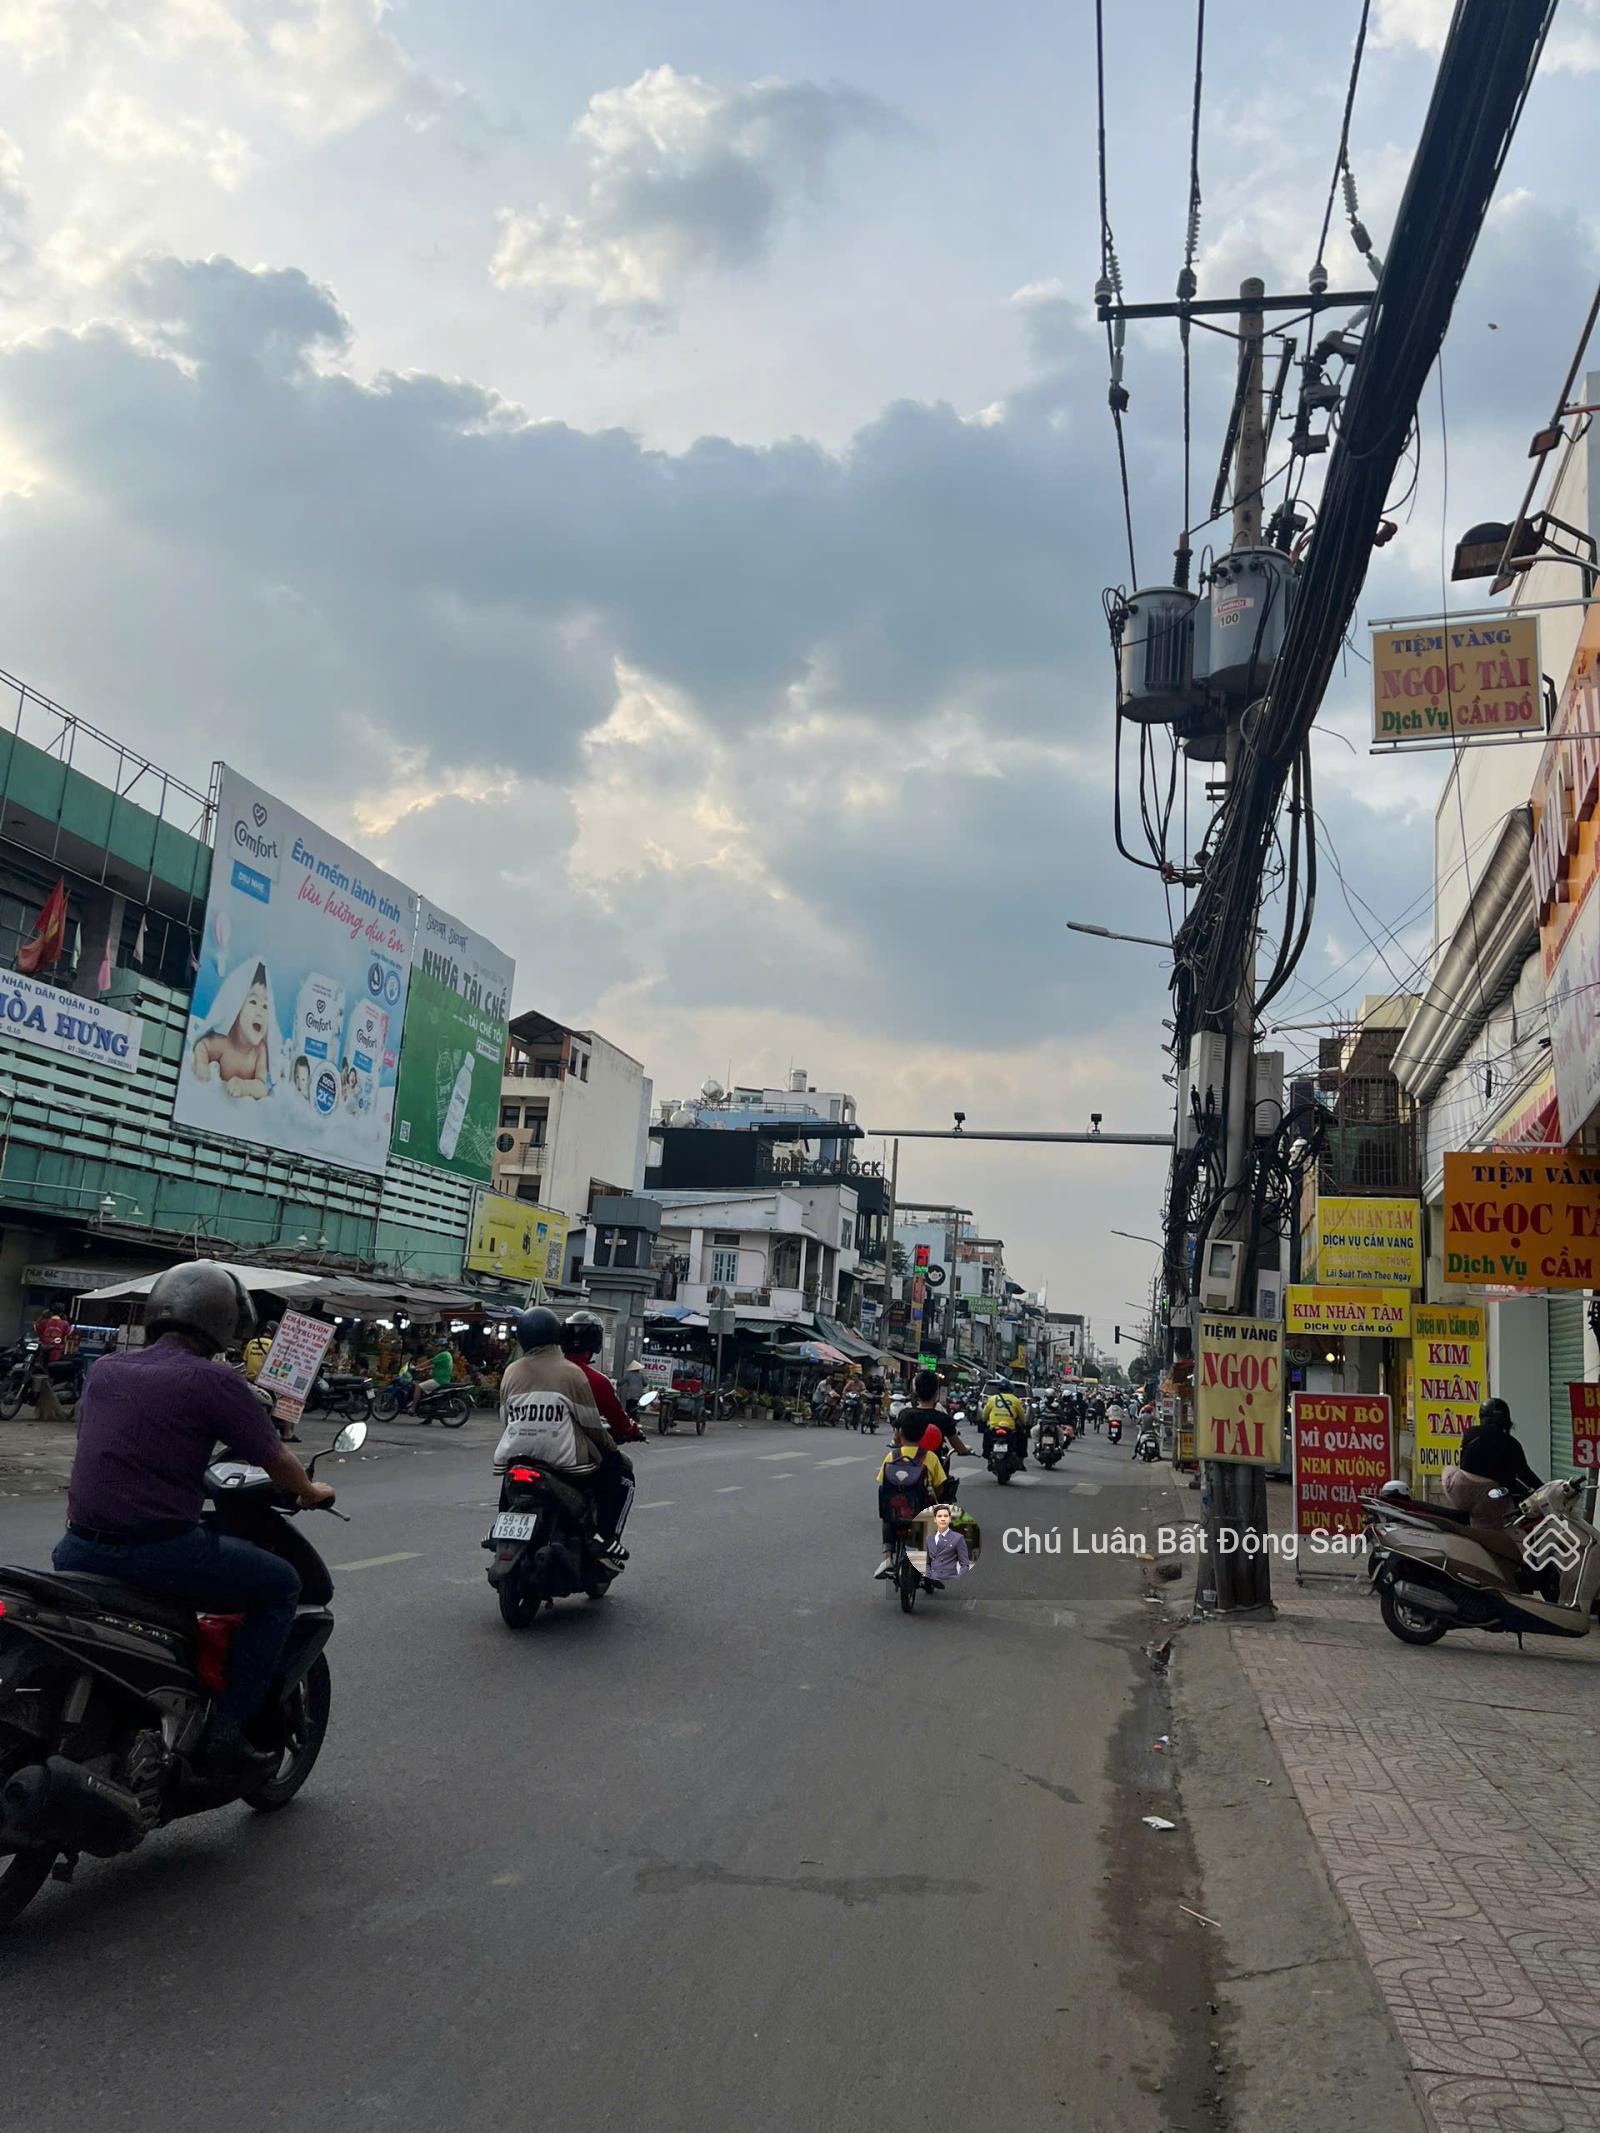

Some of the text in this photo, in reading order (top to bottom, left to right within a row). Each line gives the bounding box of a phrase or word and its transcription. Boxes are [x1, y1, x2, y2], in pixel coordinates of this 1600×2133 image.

[1221, 612, 1239, 627] 100
[1392, 628, 1511, 657] TIỆM VÀNG
[1381, 649, 1531, 706] NGỌC TÀI
[1382, 691, 1533, 735] Dịch Vụ CẦM ĐỒ
[234, 820, 279, 859] Comfort
[291, 838, 314, 870] Êm
[315, 864, 350, 891] mềm
[351, 877, 377, 909] lành
[378, 896, 400, 923] tính
[422, 948, 459, 992] NHỰA
[463, 972, 482, 1009] TÁI
[485, 987, 507, 1023] CHẾ
[88, 1005, 100, 1016] 10
[306, 1012, 333, 1033] Comfort
[54, 1012, 129, 1057] HƯNG
[356, 1028, 378, 1049] Comfort
[1472, 1160, 1532, 1189] TIỆM
[1450, 1202, 1552, 1248] NGỌC
[1323, 1235, 1345, 1248] DỊCH
[1348, 1236, 1361, 1250] VỤ
[1448, 1246, 1592, 1280] Dịch Vụ CẦM
[1375, 1271, 1391, 1280] Theo
[1293, 1304, 1320, 1318] KIM
[1326, 1302, 1366, 1319] NHÂN
[1371, 1303, 1403, 1321] TÂM
[1203, 1322, 1277, 1341] TIỆM VÀNG
[1304, 1322, 1329, 1332] DỊCH
[1333, 1324, 1346, 1332] VỤ
[1428, 1344, 1470, 1365] KIM
[1201, 1352, 1278, 1406] NGỌC
[1420, 1374, 1479, 1400] NHÂN
[1300, 1401, 1384, 1423] BÚN BÒ
[1427, 1408, 1473, 1434] TÂM
[1211, 1404, 1265, 1457] TÀI
[1300, 1426, 1385, 1452] MÌ QUẢNG
[1301, 1455, 1385, 1477] NEM NƯỚNG
[1420, 1448, 1439, 1469] DỊCH
[1302, 1480, 1327, 1500] BÚN
[1331, 1480, 1357, 1503] CHẢ
[1302, 1507, 1330, 1528] BÚN
[1335, 1509, 1352, 1530] CÁ
